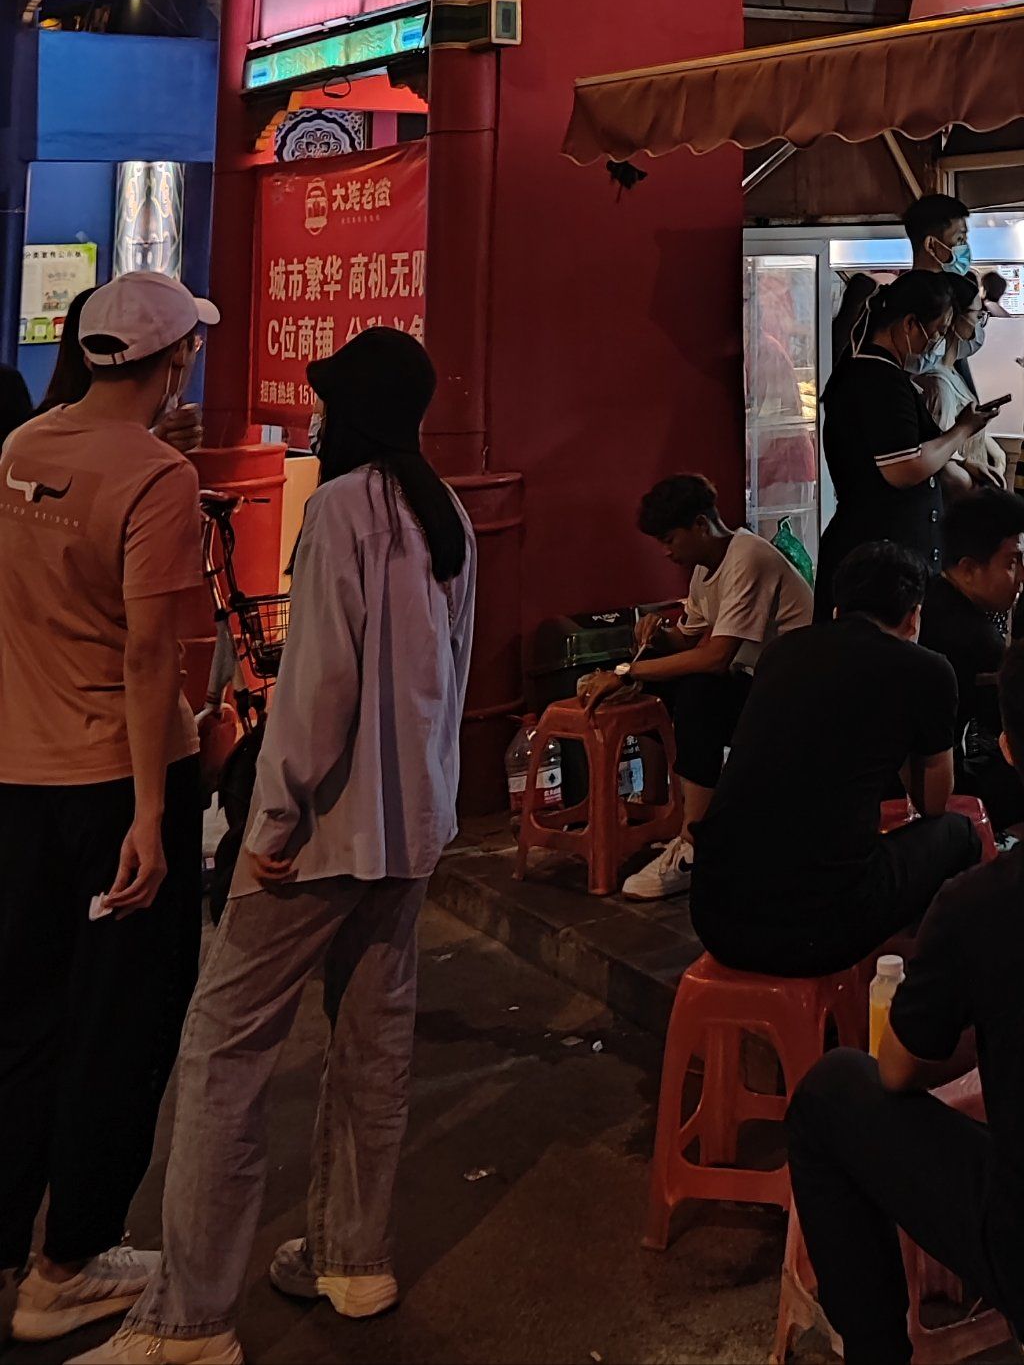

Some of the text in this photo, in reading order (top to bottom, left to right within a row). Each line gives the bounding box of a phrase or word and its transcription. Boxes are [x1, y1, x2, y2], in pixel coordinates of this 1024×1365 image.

[268, 254, 343, 301] 城市繁华
[267, 316, 335, 361] C位商铺
[260, 380, 295, 406] 招商热线
